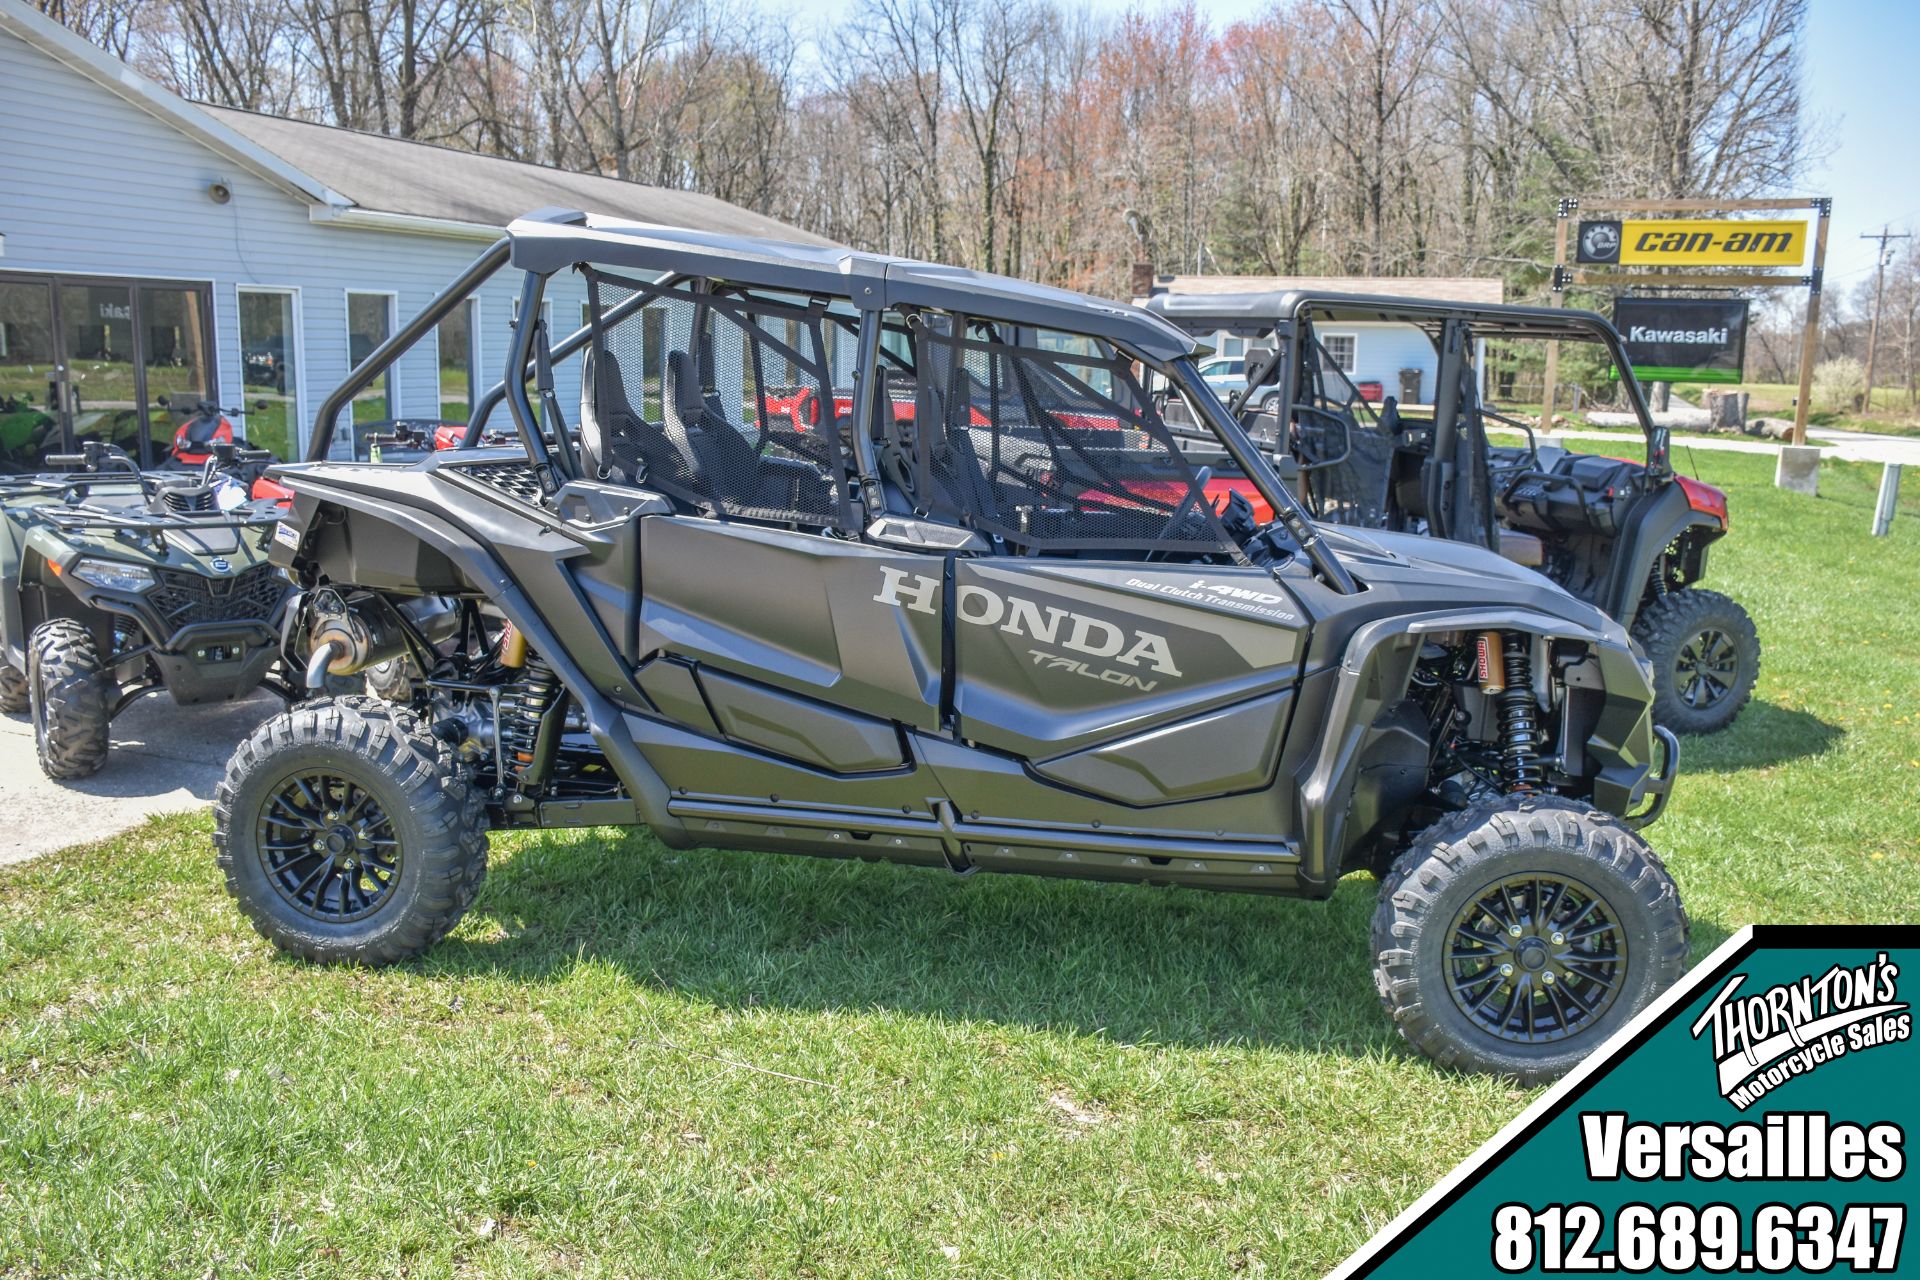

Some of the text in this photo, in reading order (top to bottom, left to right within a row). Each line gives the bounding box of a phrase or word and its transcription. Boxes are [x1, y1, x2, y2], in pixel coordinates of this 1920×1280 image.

[1633, 231, 1793, 253] can-am
[1629, 325, 1728, 345] Kawasaki
[1124, 577, 1296, 621] Dual Clutch Transmission
[872, 565, 1183, 678] HONDA
[1026, 649, 1158, 693] TALON
[1476, 640, 1488, 679] SHOWA
